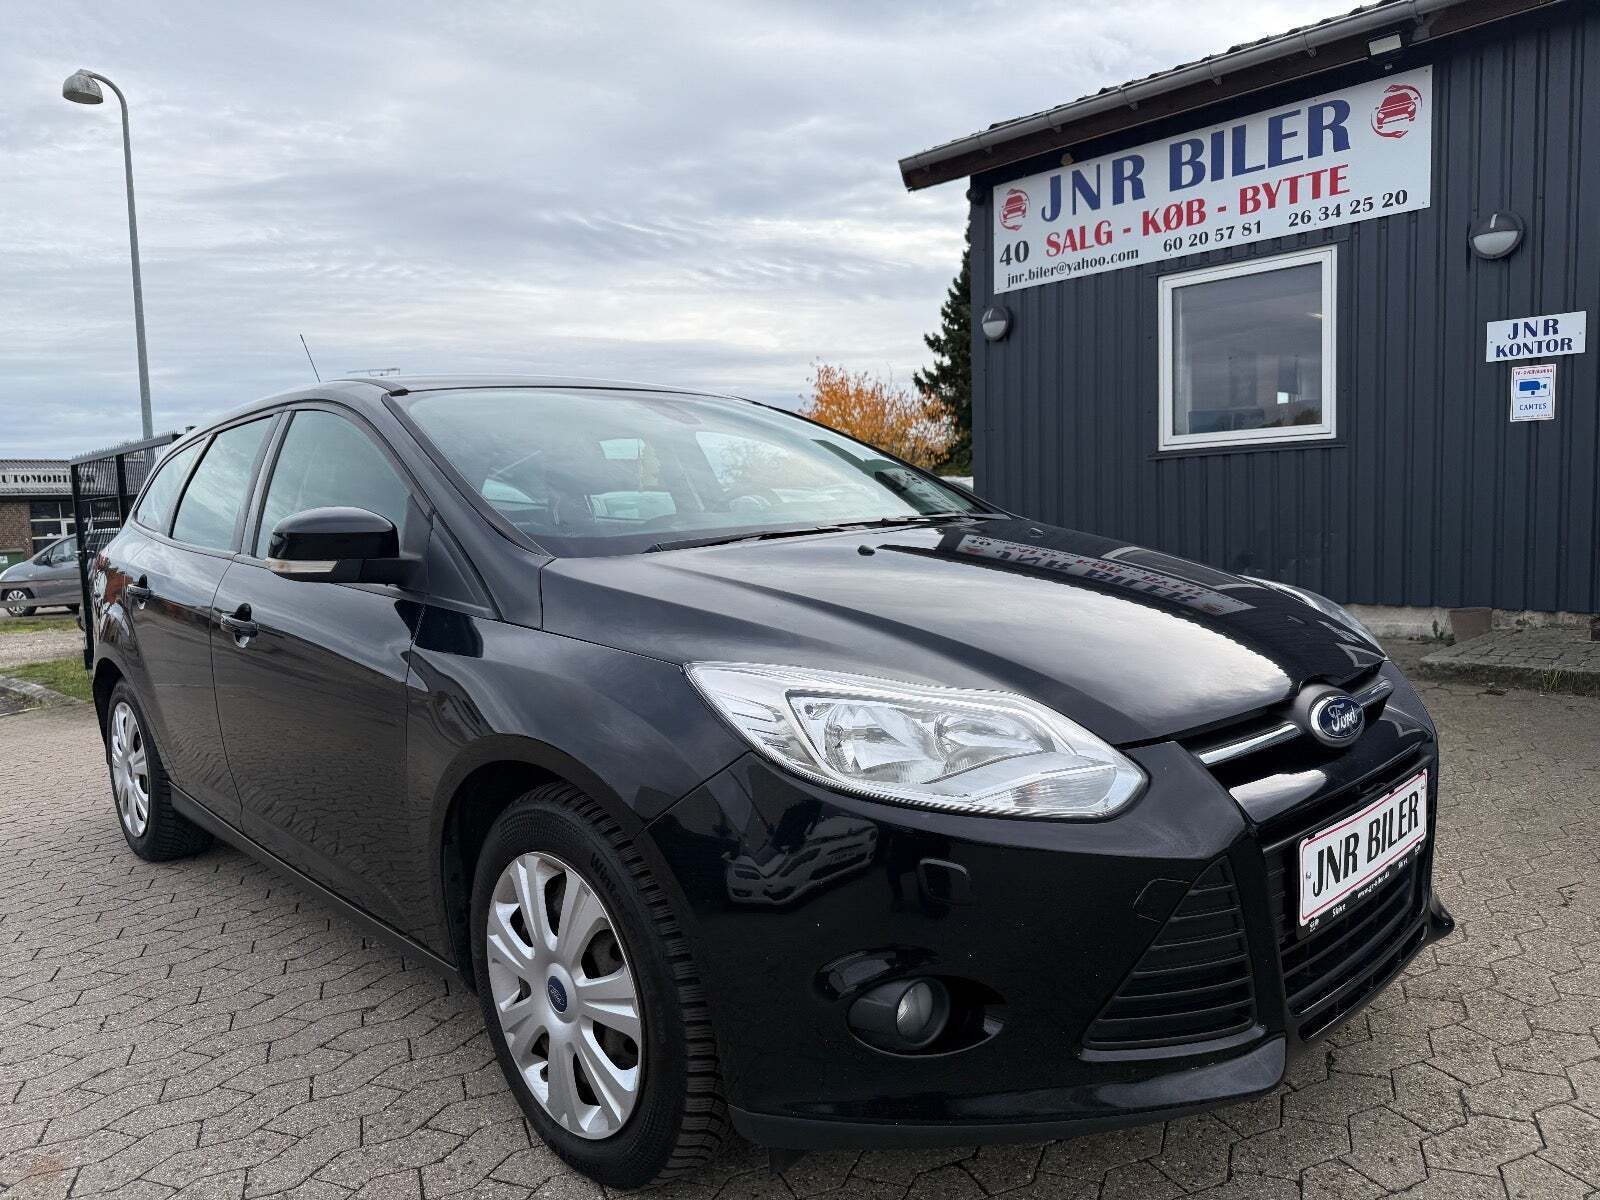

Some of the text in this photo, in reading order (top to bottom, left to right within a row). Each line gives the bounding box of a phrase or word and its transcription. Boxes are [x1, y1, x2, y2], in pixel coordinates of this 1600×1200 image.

[1041, 99, 1351, 223] JNR BILER
[1046, 220, 1113, 257] SALG
[1142, 198, 1207, 237] KØB
[1239, 164, 1351, 216] BYTTE
[1288, 189, 1408, 228] 26 34 25 20
[1000, 240, 1030, 266] 40
[1163, 220, 1261, 252] 60 20 57 81
[1007, 248, 1139, 288] jnr.biler@yahoo.com
[1508, 318, 1560, 341] JNR
[1495, 337, 1573, 358] KONTOR
[1327, 702, 1358, 732] Ford
[1312, 831, 1360, 898] JNR
[1366, 790, 1419, 865] BILER
